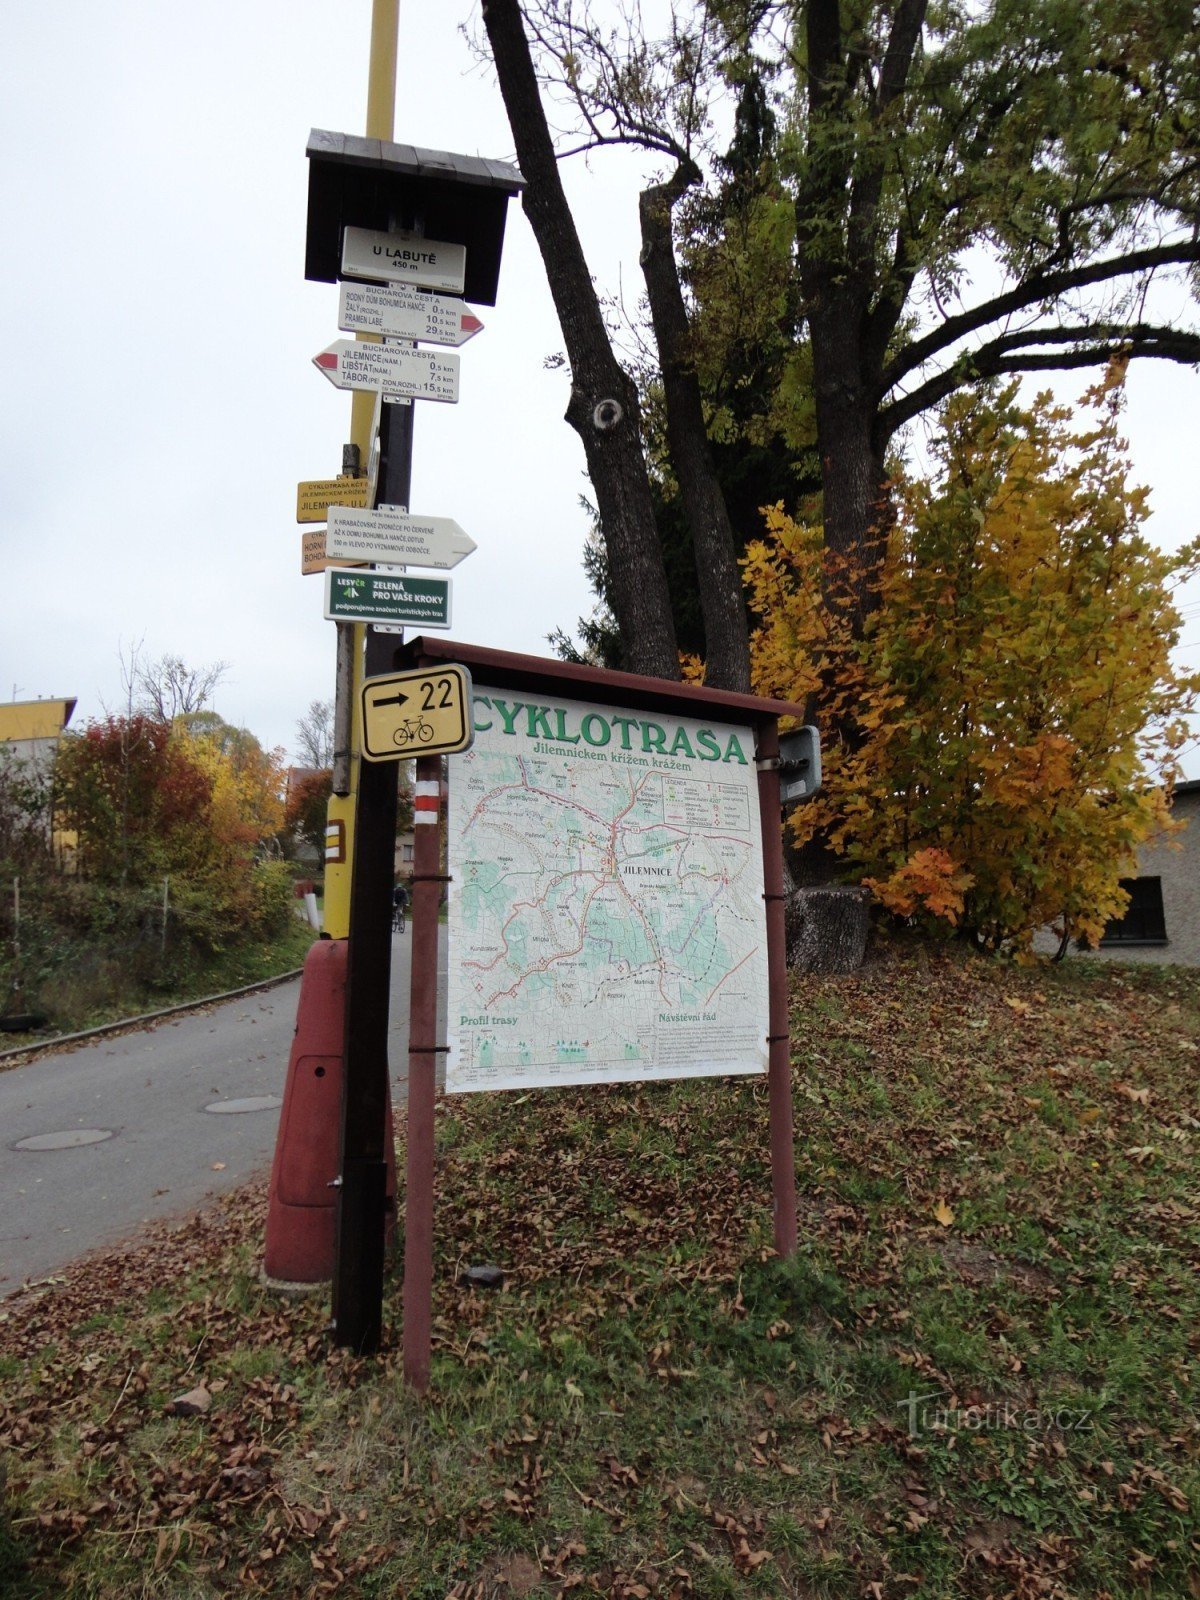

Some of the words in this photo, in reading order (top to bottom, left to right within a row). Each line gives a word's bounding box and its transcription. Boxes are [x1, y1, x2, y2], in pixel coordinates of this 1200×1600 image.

[373, 245, 382, 255] U
[385, 247, 437, 265] LABUTĚ
[392, 260, 408, 269] 450
[366, 287, 413, 299] BUCHAROVA
[366, 294, 378, 305] DŮM
[378, 296, 407, 309] BOHUMILA
[406, 300, 426, 312] HANČE
[445, 309, 457, 317] km
[344, 313, 368, 325] PRAMEN
[368, 315, 384, 327] LABE
[444, 319, 456, 327] km
[342, 350, 382, 363] JILEMNICE
[362, 344, 410, 356] BUCHAROVA
[411, 351, 436, 360] CESTA
[342, 360, 373, 372] LIBŠTÁT
[342, 371, 368, 383] TÁBOR
[308, 482, 350, 490] CYKLOTRASA
[350, 480, 364, 488] KČT
[339, 519, 377, 529] HRABAČOVSKÉ
[377, 522, 403, 532] ZVONIČCE
[411, 525, 435, 535] ČERVENÉ
[362, 532, 389, 540] BOHUMILA
[373, 581, 405, 592] ZELENÁ
[372, 591, 391, 600] PRO
[391, 592, 413, 602] VAŠE
[414, 595, 444, 605] KROKY
[335, 603, 375, 613] podporujeme
[375, 606, 398, 614] značení
[398, 607, 432, 617] turistických
[420, 678, 453, 712] 22
[473, 698, 749, 766] CYKLOTRASA
[610, 749, 650, 767] křížem
[651, 752, 692, 772] krážem
[623, 866, 673, 877] JILEMNICE
[460, 1015, 489, 1026] Profil
[492, 1016, 518, 1026] trasy
[659, 1012, 700, 1022] Návštěvní
[702, 1012, 717, 1021] řád
